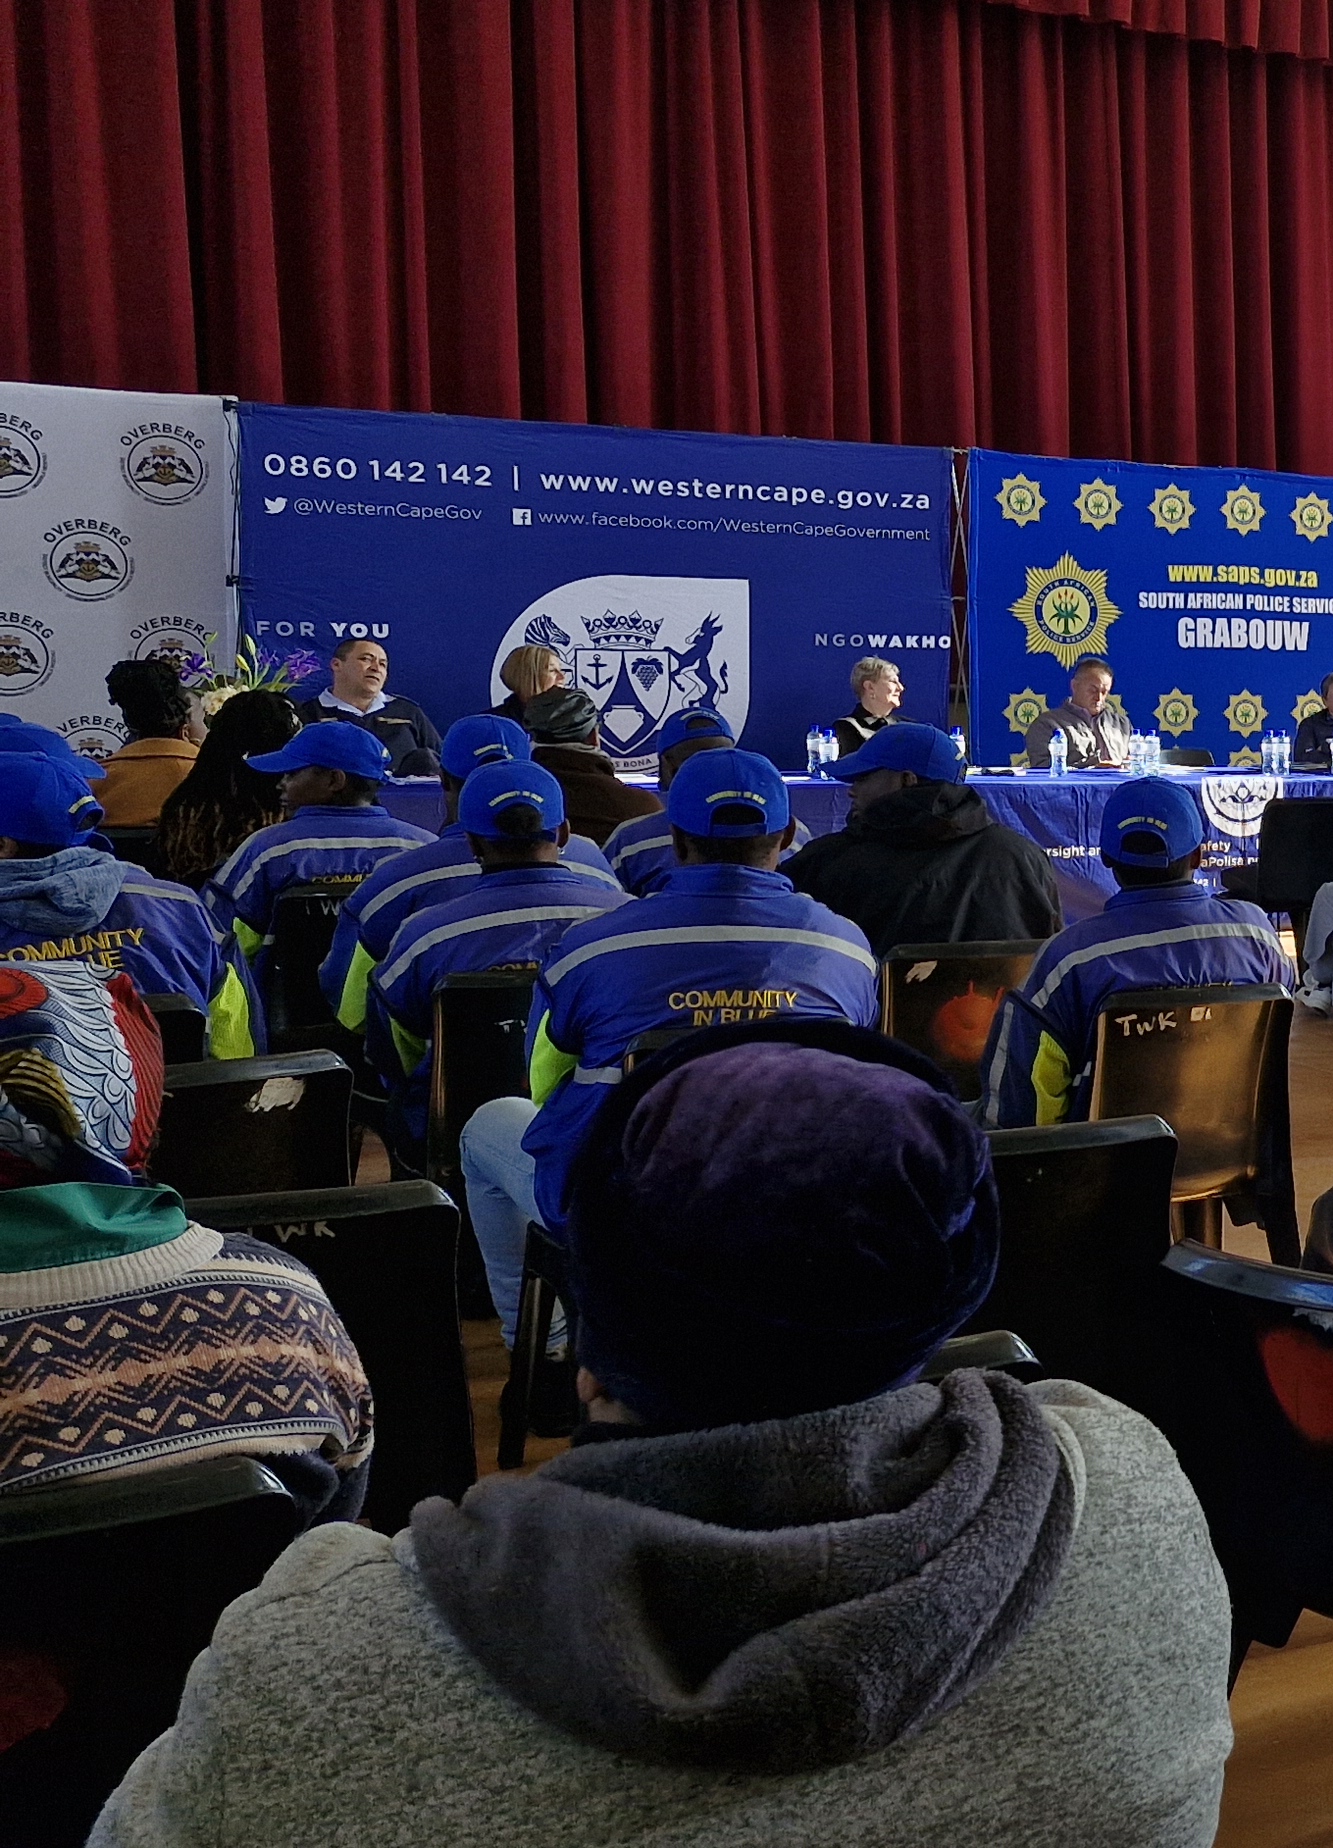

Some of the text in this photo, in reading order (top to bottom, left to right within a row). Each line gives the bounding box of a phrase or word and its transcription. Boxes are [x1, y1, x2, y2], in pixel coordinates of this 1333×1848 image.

[120, 422, 206, 450] OVERBERG
[264, 453, 357, 479] 0860
[369, 460, 426, 483] 142
[437, 463, 492, 486] 142
[540, 471, 931, 510] www.westerncape.gov.za
[293, 497, 483, 520] @WesternCapeGov
[43, 518, 131, 547] OVERBERG
[538, 510, 931, 542] www.facebook.com/WesternCapeGovernment
[1167, 564, 1318, 588] www.saps.gov.za
[1138, 591, 1185, 608] SOUTH
[1187, 592, 1243, 610] AFRICAN
[1246, 594, 1290, 612] POLICE
[256, 620, 389, 639] FOR YOU
[1177, 616, 1310, 651] GRABOUW
[56, 714, 131, 739] VERBER
[623, 758, 652, 768] BONA
[1044, 845, 1085, 859] rsight
[1200, 840, 1231, 853] afety
[1200, 855, 1244, 868] aPolisa
[0, 927, 144, 962] OMMUNITY
[668, 989, 798, 1010] COMMUNITY
[693, 1009, 713, 1026] IN
[1114, 1010, 1178, 1037] TWK
